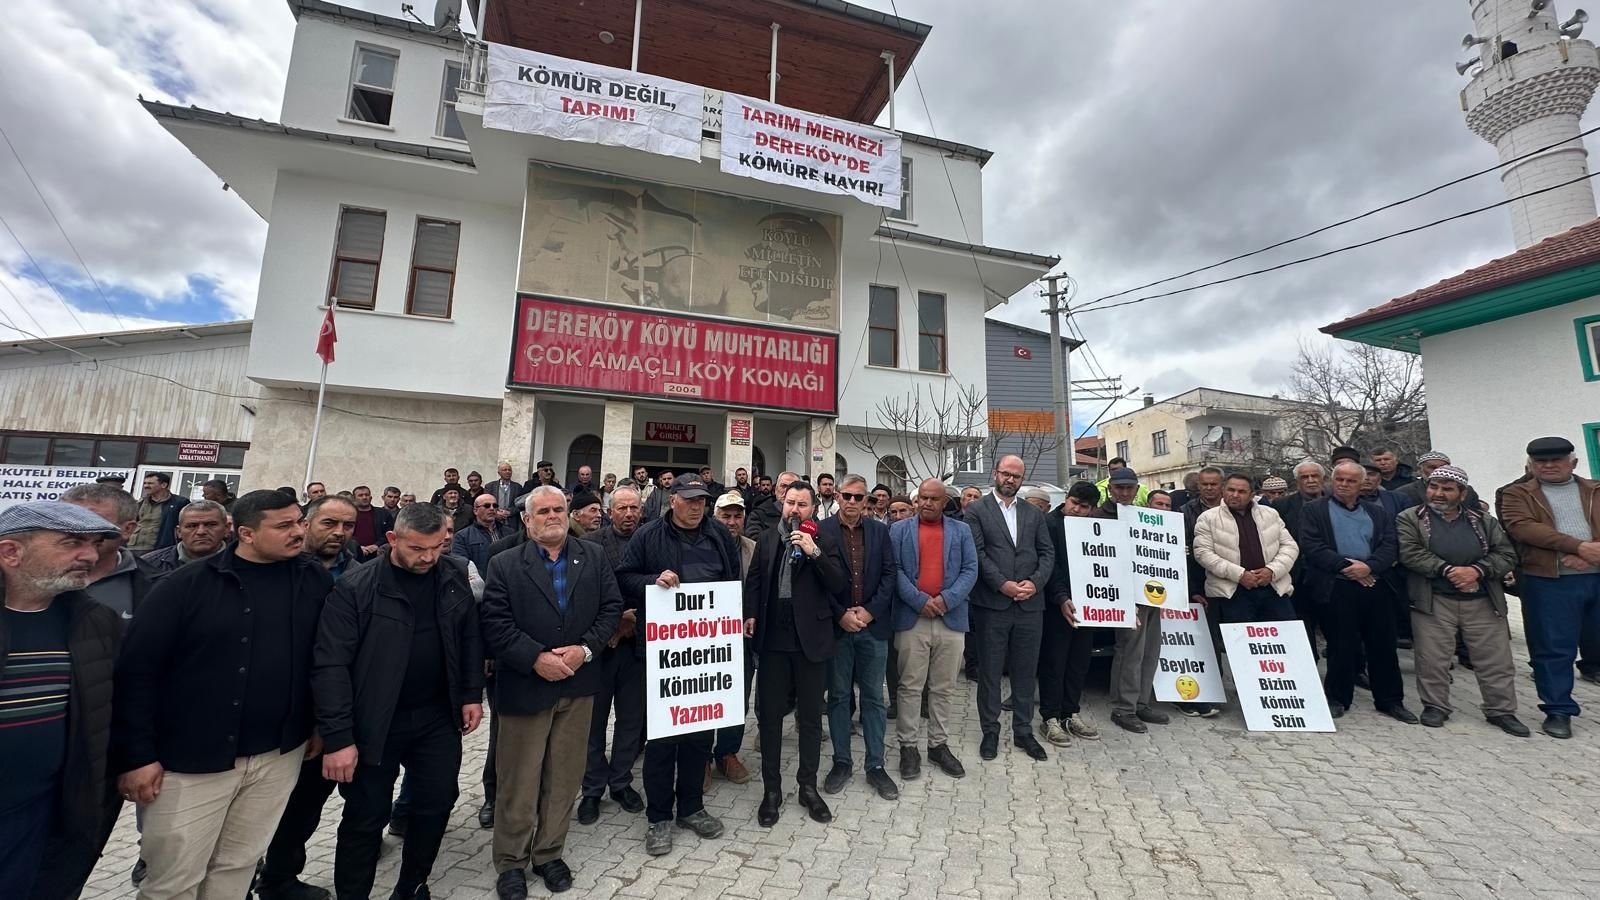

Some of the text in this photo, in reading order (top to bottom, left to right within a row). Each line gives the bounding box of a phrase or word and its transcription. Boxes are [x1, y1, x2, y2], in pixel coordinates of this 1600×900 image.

[517, 65, 602, 94] KÖMÜR
[608, 82, 677, 111] DEĞİL,
[560, 96, 635, 122] TARIM!
[742, 105, 884, 157] TARIM MERKEZİ
[755, 132, 870, 174] DEREKÖY'DE
[739, 152, 884, 197] KÖMÜRE HAYIR!
[752, 247, 822, 268] MİLLETİN
[526, 307, 829, 366] DEREKÖY KÖYÜ MUHTARLIĞI
[526, 344, 824, 392] ÇOK AMAÇLI KÖY KONAĞI
[668, 385, 697, 395] 2004
[656, 423, 686, 432] MARKET
[0, 468, 52, 478] KUTELİ
[3, 480, 43, 489] HALK
[0, 491, 61, 501] ATIŞ NO
[1137, 511, 1164, 527] Yeşil
[1093, 522, 1101, 537] O
[1141, 529, 1164, 544] Arar
[1165, 532, 1178, 545] La
[1081, 541, 1116, 558] Kadın
[1136, 544, 1171, 562] Kömür
[1093, 563, 1109, 578] Bu
[1086, 579, 1120, 602] Ocağı
[675, 592, 705, 612] Dur
[1083, 605, 1126, 624] Kapatır
[646, 616, 742, 642] Dereköy'ün
[1246, 625, 1279, 638] Dere
[659, 643, 732, 669] Kaderini
[1248, 642, 1287, 655] Bizim
[1160, 657, 1205, 674] Beyler
[1258, 659, 1285, 674] Köy
[660, 673, 732, 699] Kömürle
[1258, 677, 1297, 691] Bizim
[1259, 694, 1305, 710] Kömür
[670, 702, 724, 726] Yazma
[1271, 714, 1306, 729] Sizin
